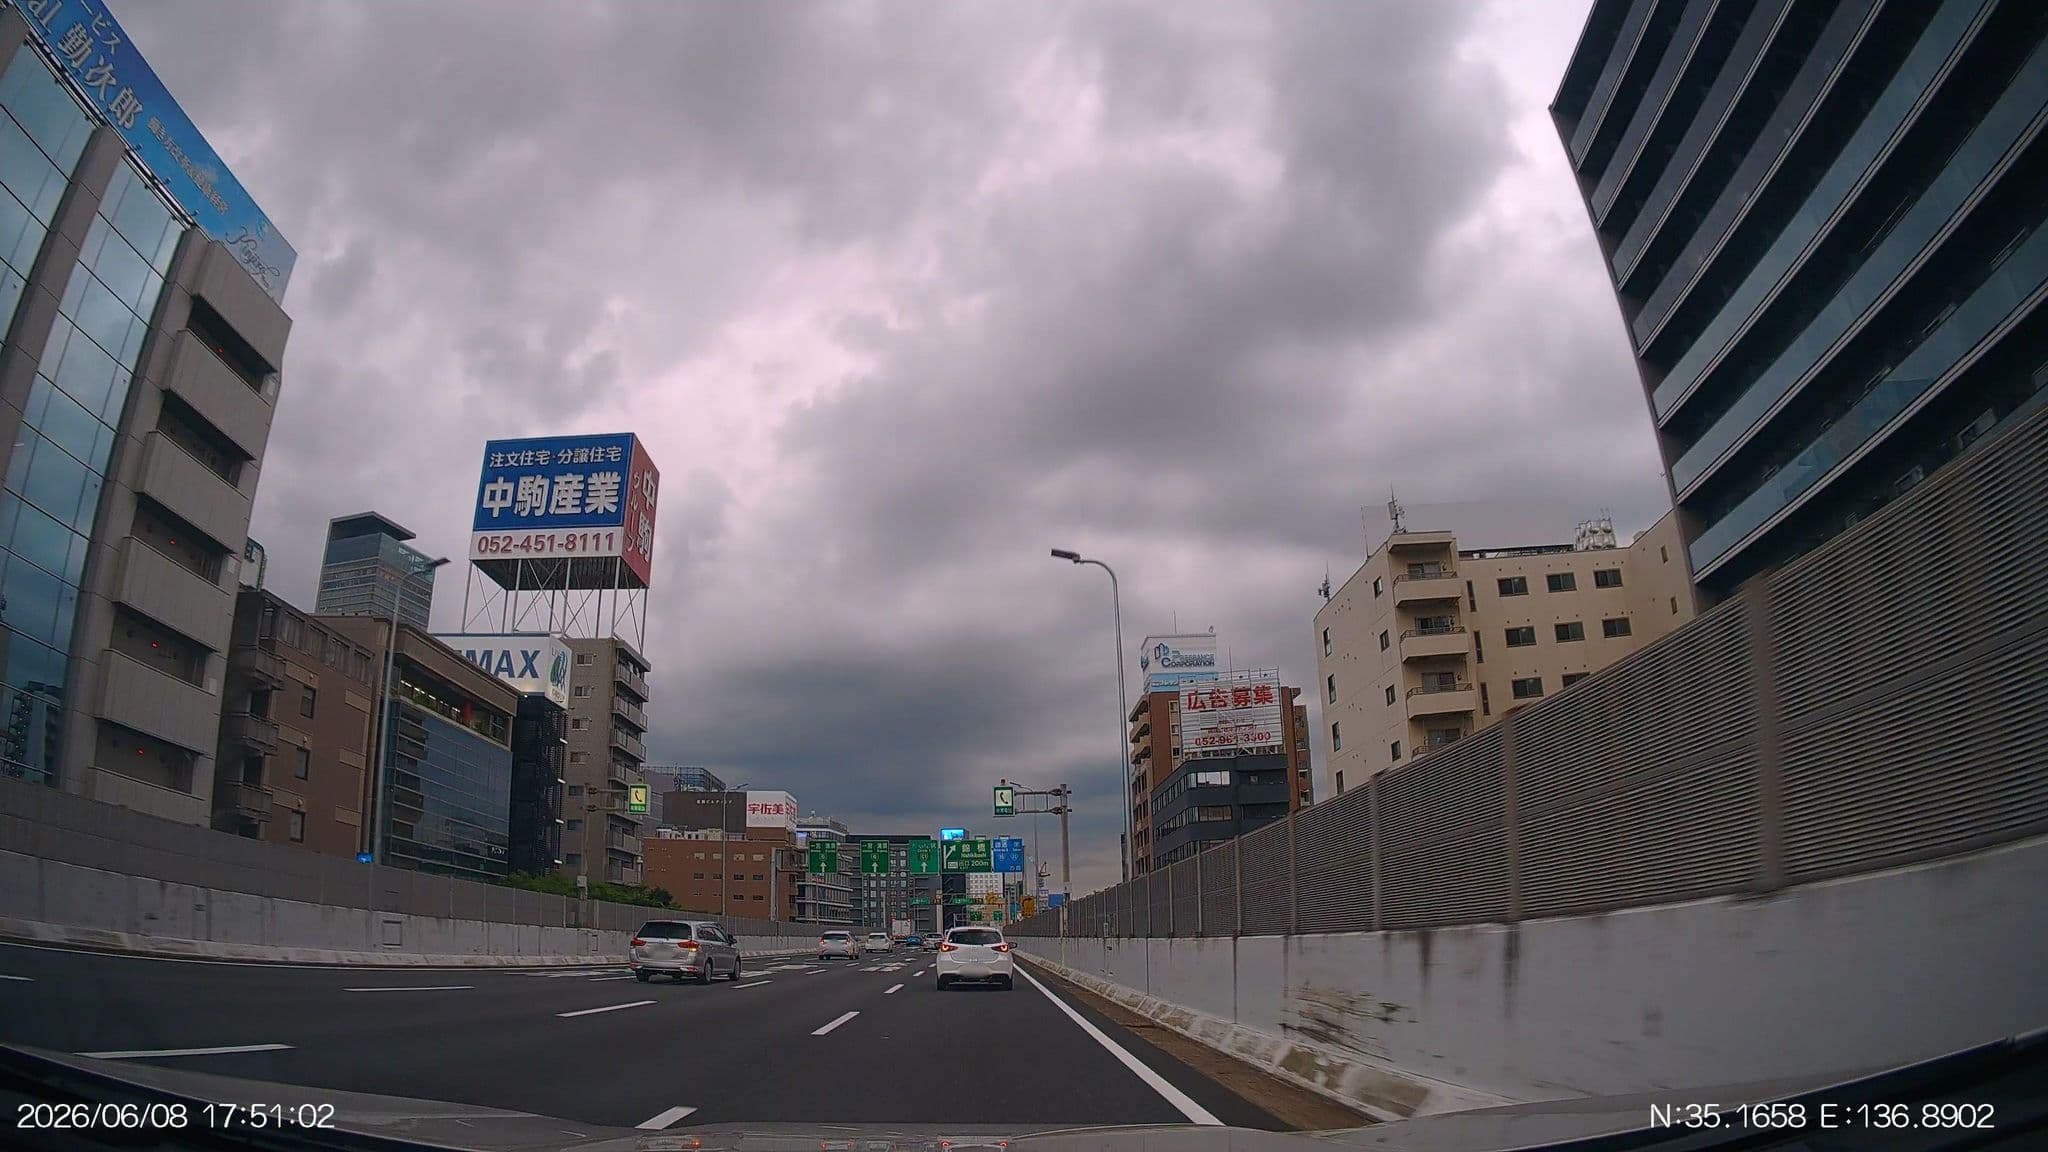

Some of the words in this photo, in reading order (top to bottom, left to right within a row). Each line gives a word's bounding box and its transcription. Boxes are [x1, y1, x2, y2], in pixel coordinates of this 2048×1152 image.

[482, 471, 621, 518] 中駒産業
[477, 532, 615, 554] 052-451-8111
[1187, 684, 1274, 711] 広告募集
[748, 803, 785, 815] 宇佐美
[971, 859, 989, 867] 200m
